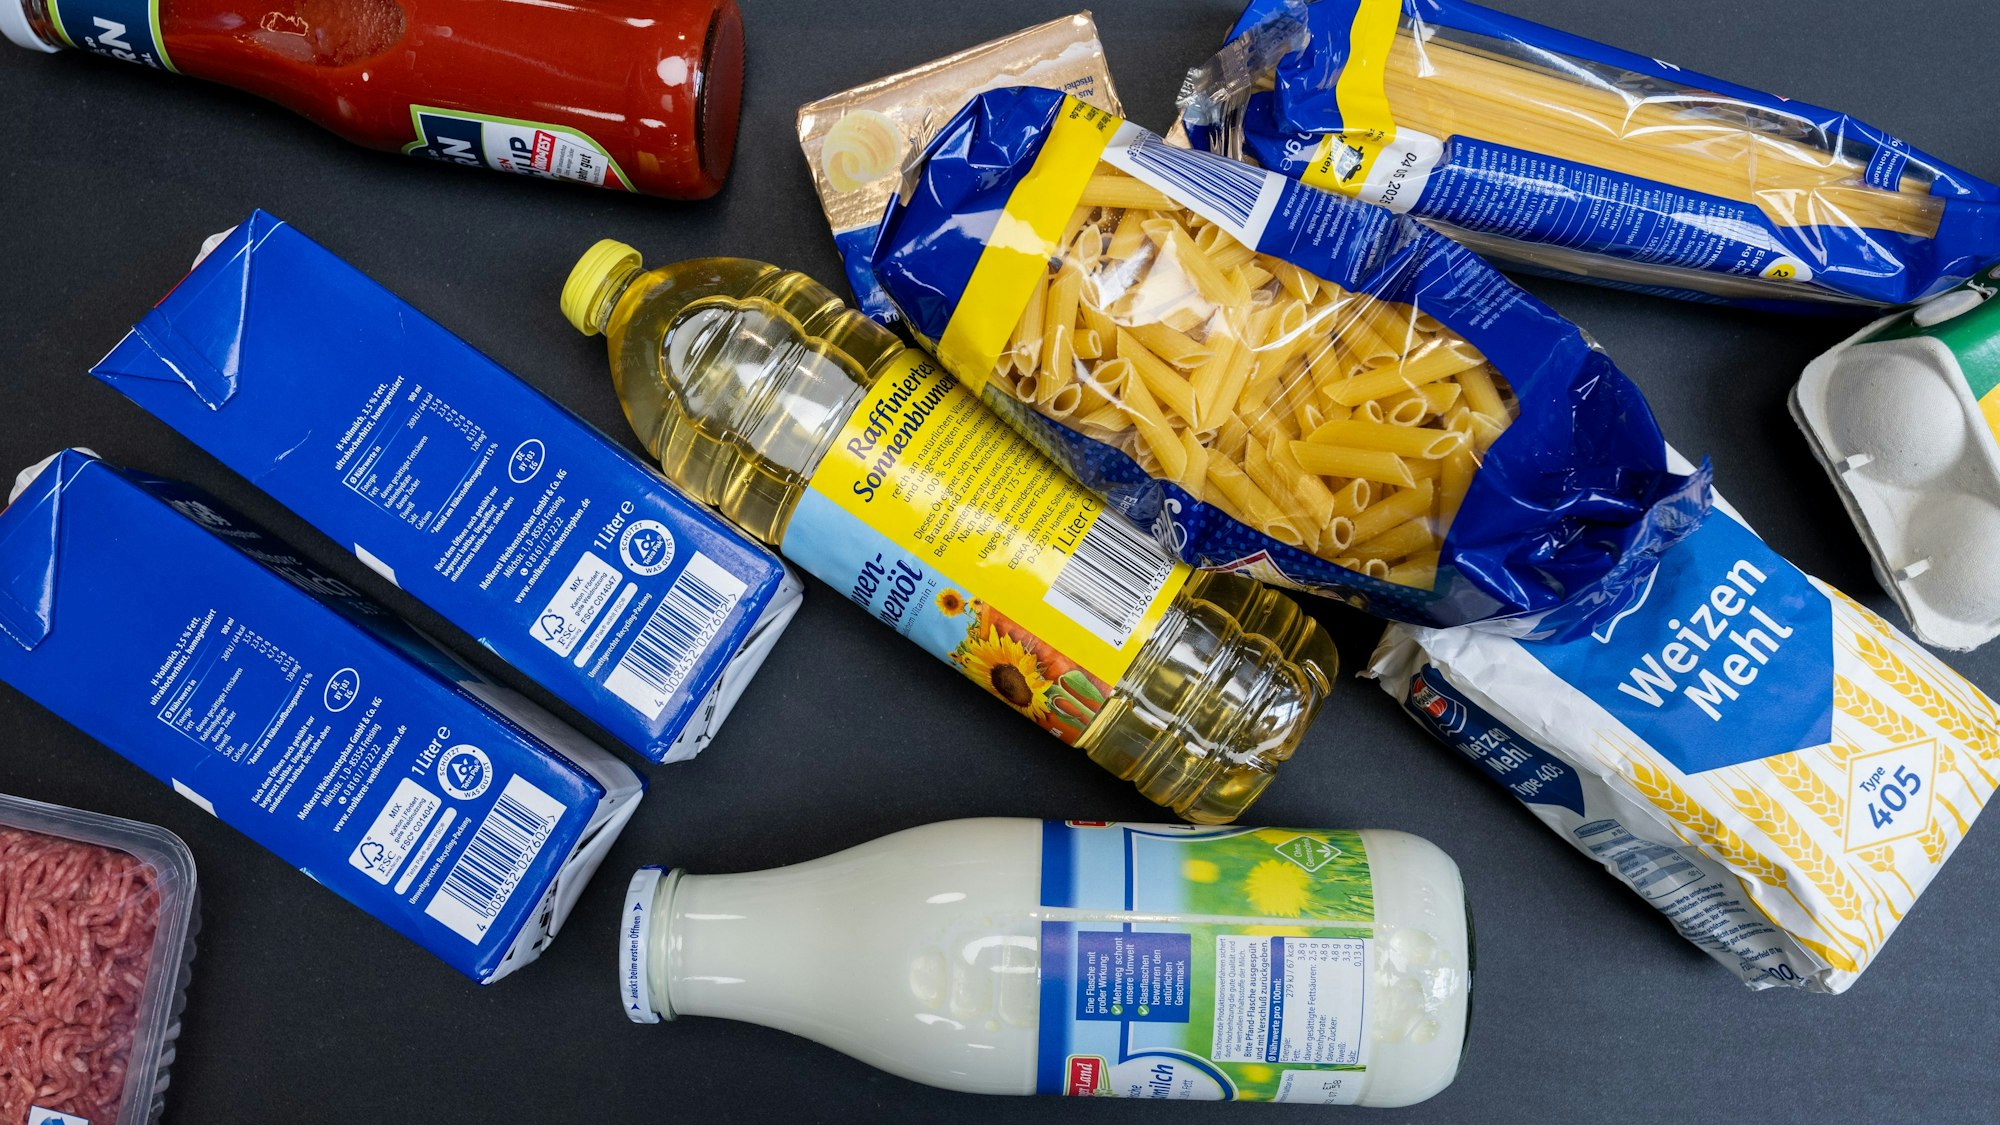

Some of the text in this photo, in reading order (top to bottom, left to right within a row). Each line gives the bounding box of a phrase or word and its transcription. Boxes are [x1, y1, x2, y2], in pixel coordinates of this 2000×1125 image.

[1064, 75, 1094, 92] frischer
[1079, 87, 1094, 99] Aus
[580, 153, 593, 169] gut
[1379, 152, 1417, 205] 04 05 2025
[1751, 250, 1765, 268] Eier
[335, 415, 367, 451] H-Vollmilch,
[361, 402, 373, 415] 3,5
[373, 383, 388, 398] Fett,
[335, 375, 404, 470] ultrahocherhitzt, homogenisiert
[846, 360, 936, 460] Raffiniertes
[853, 365, 960, 503] Sonnenblumen
[515, 451, 525, 461] DE
[518, 450, 535, 471] BY 103
[528, 460, 538, 470] EG
[891, 394, 972, 499] reich an natürlichem Vitamin
[913, 430, 994, 540] Dieses Öl eignet sich vorzüglich
[924, 429, 1010, 544] Braten und zum Anrichten von
[975, 512, 996, 536] Nicht
[991, 493, 1008, 513] über
[1004, 477, 1020, 493] 175
[433, 485, 498, 571] Nach dem Öffnen auch gekühlt nur
[441, 504, 497, 577] begrenzt haltbar. Ungeöffnet
[450, 496, 514, 582] mindestens haltbar bis: siehe oben
[479, 560, 504, 590] Molkerei
[498, 515, 537, 563] Weihenstephan
[532, 494, 550, 516] GmbH
[549, 480, 561, 490] Co.
[555, 468, 567, 480] KG
[502, 552, 525, 578] Milchstr.
[543, 495, 565, 520] Freising
[593, 512, 625, 549] 1 Liter
[977, 472, 1042, 559] Ungeöffnet mindestens
[1007, 484, 1072, 570] EDEKA ZENTRALE Stiftung
[1052, 511, 1088, 554] 1 Liter
[514, 498, 591, 603] www.molkerei-weihenstephan.de
[1026, 530, 1052, 564] D-22291
[569, 577, 583, 591] MIX
[593, 575, 616, 606] C014047
[557, 623, 574, 646] FSC
[587, 592, 652, 678] Umweltgerechte Recycling-Packung
[1121, 594, 1152, 634] 311596
[1618, 560, 1767, 708] Weizen
[150, 650, 181, 686] H-Vollmilch,
[175, 637, 187, 649] 3,5
[186, 617, 201, 632] Fett,
[150, 608, 216, 705] ultrahocherhitzt, homogenisiert
[654, 602, 731, 707] 4 008452 027602
[1683, 605, 1794, 722] Mehl
[297, 790, 321, 820] Molkerei
[316, 743, 354, 792] Weihenstephan
[349, 722, 366, 744] GmbH
[365, 708, 377, 718] Co.
[371, 696, 382, 708] KG
[411, 738, 442, 775] 1 Liter
[1456, 728, 1511, 760] Weizen
[1485, 742, 1533, 775] Mehl
[1509, 763, 1564, 797] Type 405
[1859, 766, 1886, 792] Type
[1868, 765, 1921, 829] 405
[476, 824, 551, 931] 4 008452 027602
[1294, 843, 1302, 857] Ohne
[628, 915, 641, 939] Öffnen
[630, 940, 639, 961] ersten
[628, 963, 638, 979] beim
[1085, 951, 1096, 1013] Eine Flasche mit
[1097, 953, 1109, 1014] großer Wirkung:
[1112, 937, 1124, 1004] Mehrweg schont
[1125, 944, 1134, 1004] unsere Umwelt
[1139, 954, 1149, 1005] Glasflaschen
[1151, 949, 1161, 1005] bewahren den
[1163, 961, 1173, 1005] natürlichen
[1174, 960, 1184, 1006] Geschmack
[1244, 942, 1258, 1057] Bitte Pfand-Flasche ausgespült
[1255, 939, 1269, 1061] und mit Verschluß zurückgeben.
[1273, 1005, 1281, 1019] pro
[1268, 1019, 1280, 1055] Nährwerte
[1076, 1062, 1093, 1087] Land
